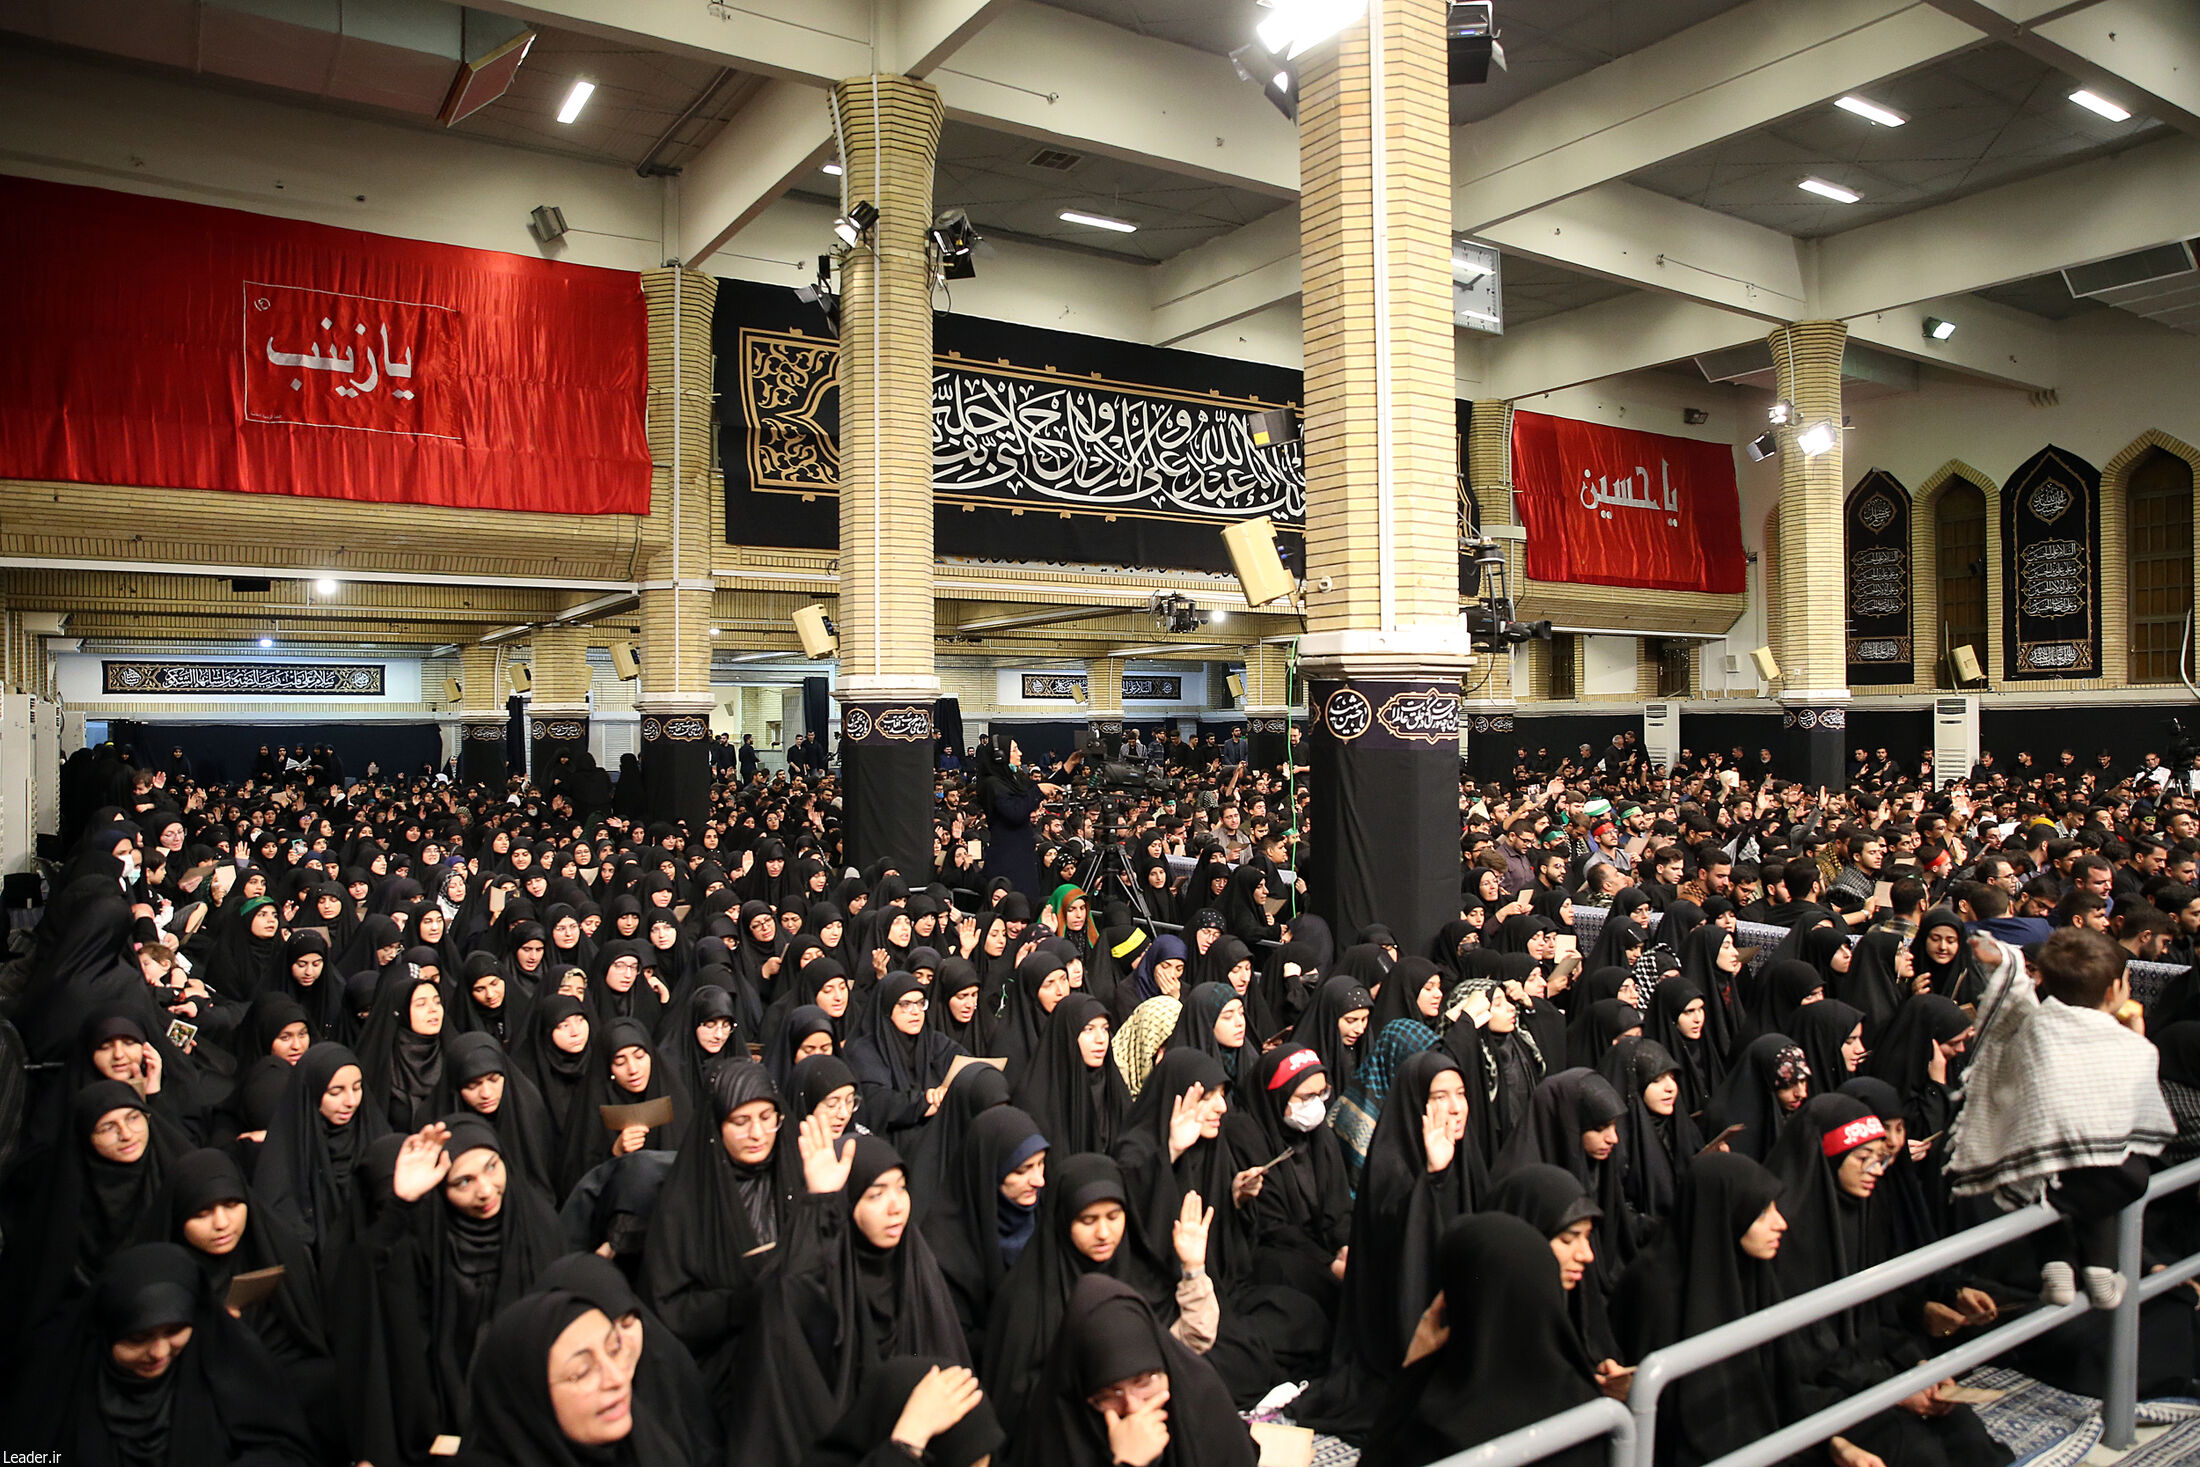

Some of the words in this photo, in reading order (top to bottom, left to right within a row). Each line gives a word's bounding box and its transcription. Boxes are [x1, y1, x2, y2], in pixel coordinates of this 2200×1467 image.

[266, 316, 379, 399] زینب
[379, 322, 415, 401] یا
[1580, 465, 1661, 520] حسین
[1661, 456, 1679, 528] یا
